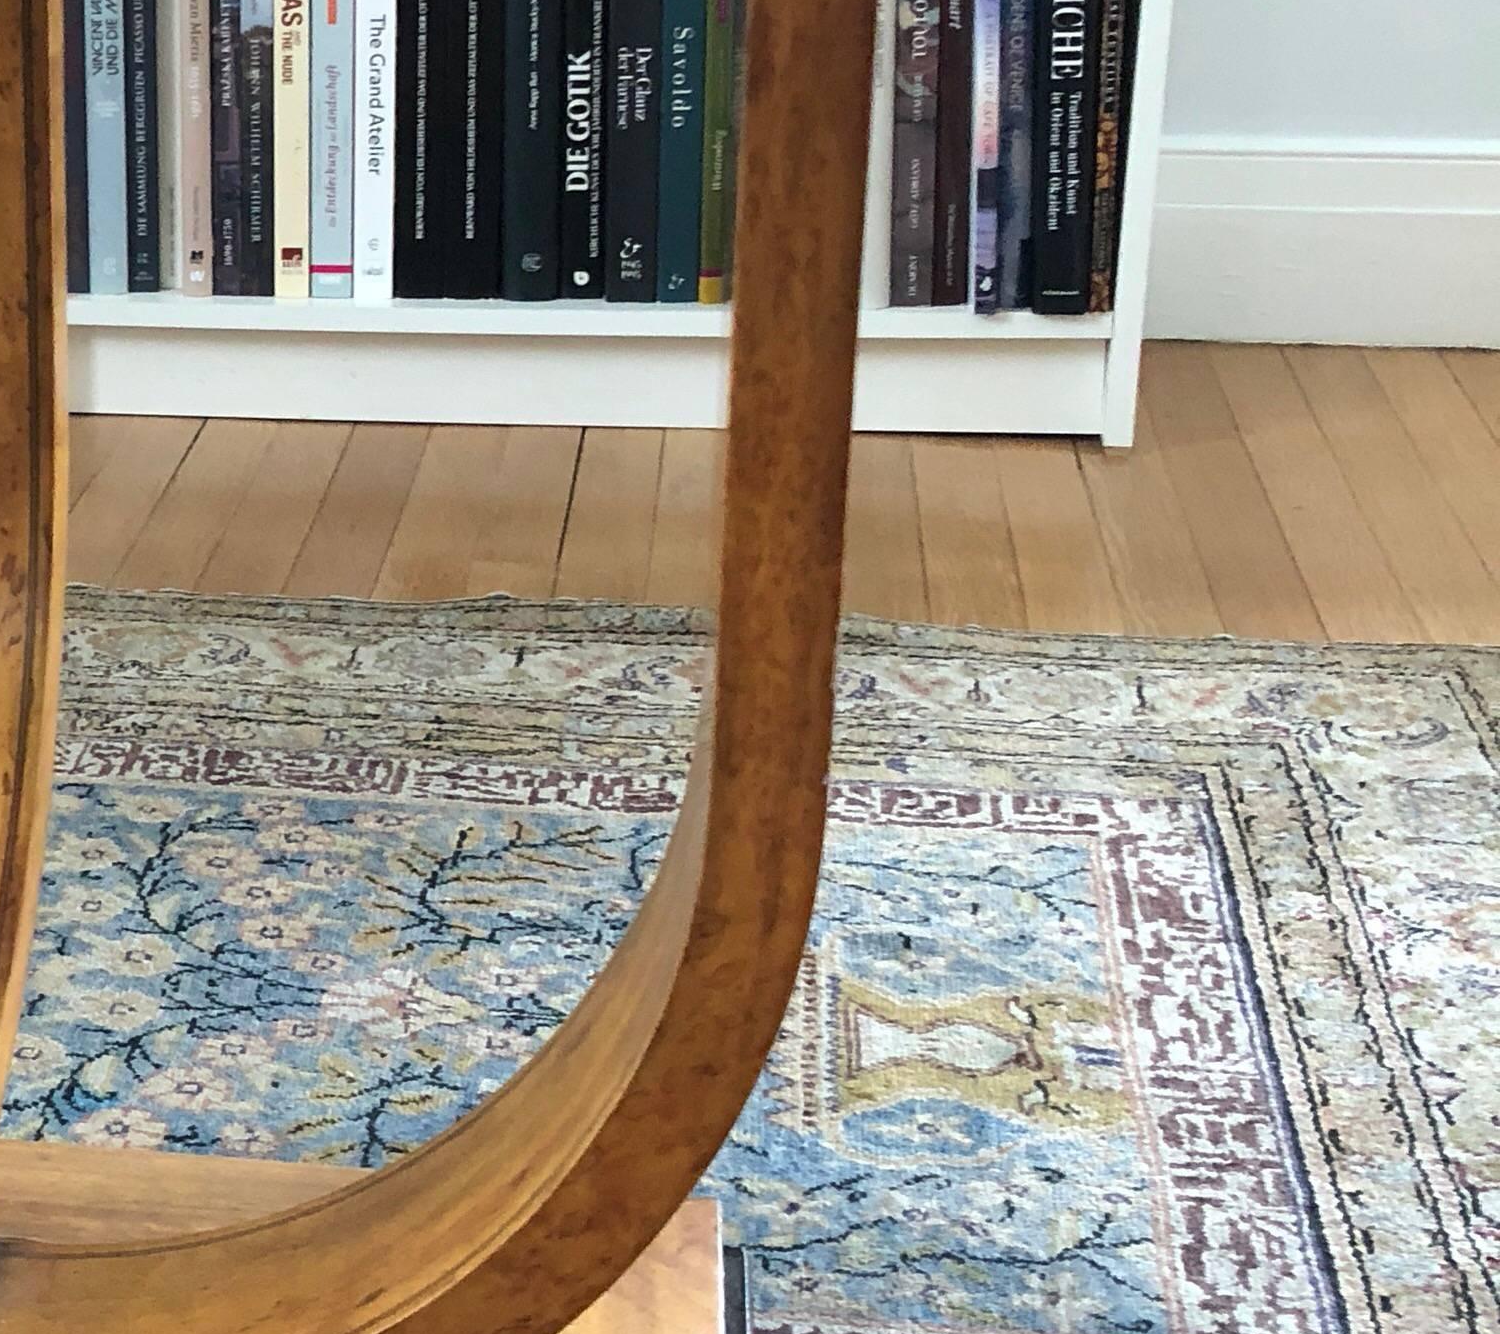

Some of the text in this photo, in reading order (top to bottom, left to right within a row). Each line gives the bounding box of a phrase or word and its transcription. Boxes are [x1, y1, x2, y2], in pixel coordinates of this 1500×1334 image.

[91, 19, 104, 76] VINCENT
[105, 19, 118, 40] DIE
[133, 15, 145, 65] PICASSO
[190, 22, 201, 62] Mieris
[105, 45, 120, 76] UND
[281, 31, 293, 85] THE NUDE
[672, 26, 695, 128] Savoldo
[134, 71, 146, 144] BERGGRUEN
[368, 13, 387, 176] The Grand Atelier
[416, 98, 425, 117] UND
[417, 79, 426, 96] DAS
[467, 98, 476, 117] UND
[468, 79, 477, 96] DAS
[616, 46, 634, 130] der Farnese
[634, 46, 653, 122] Der Glanz
[1008, 59, 1024, 111] VENICE
[249, 39, 262, 243] JOHANN WILHELM SCHIRMER
[324, 64, 340, 214] Entdeckung Landschaft
[565, 50, 591, 192] DIE GOTIK
[1047, 91, 1065, 231] in Orient und Okzident
[1065, 91, 1082, 215] Tradition und Kunst
[135, 147, 147, 215] SAMMLUNG
[416, 172, 425, 191] VON
[467, 172, 476, 191] VON
[137, 218, 147, 237] DIE
[415, 193, 424, 239] BERNWARD
[466, 193, 475, 239] BERNWARD
[908, 254, 919, 297] DUMONT
